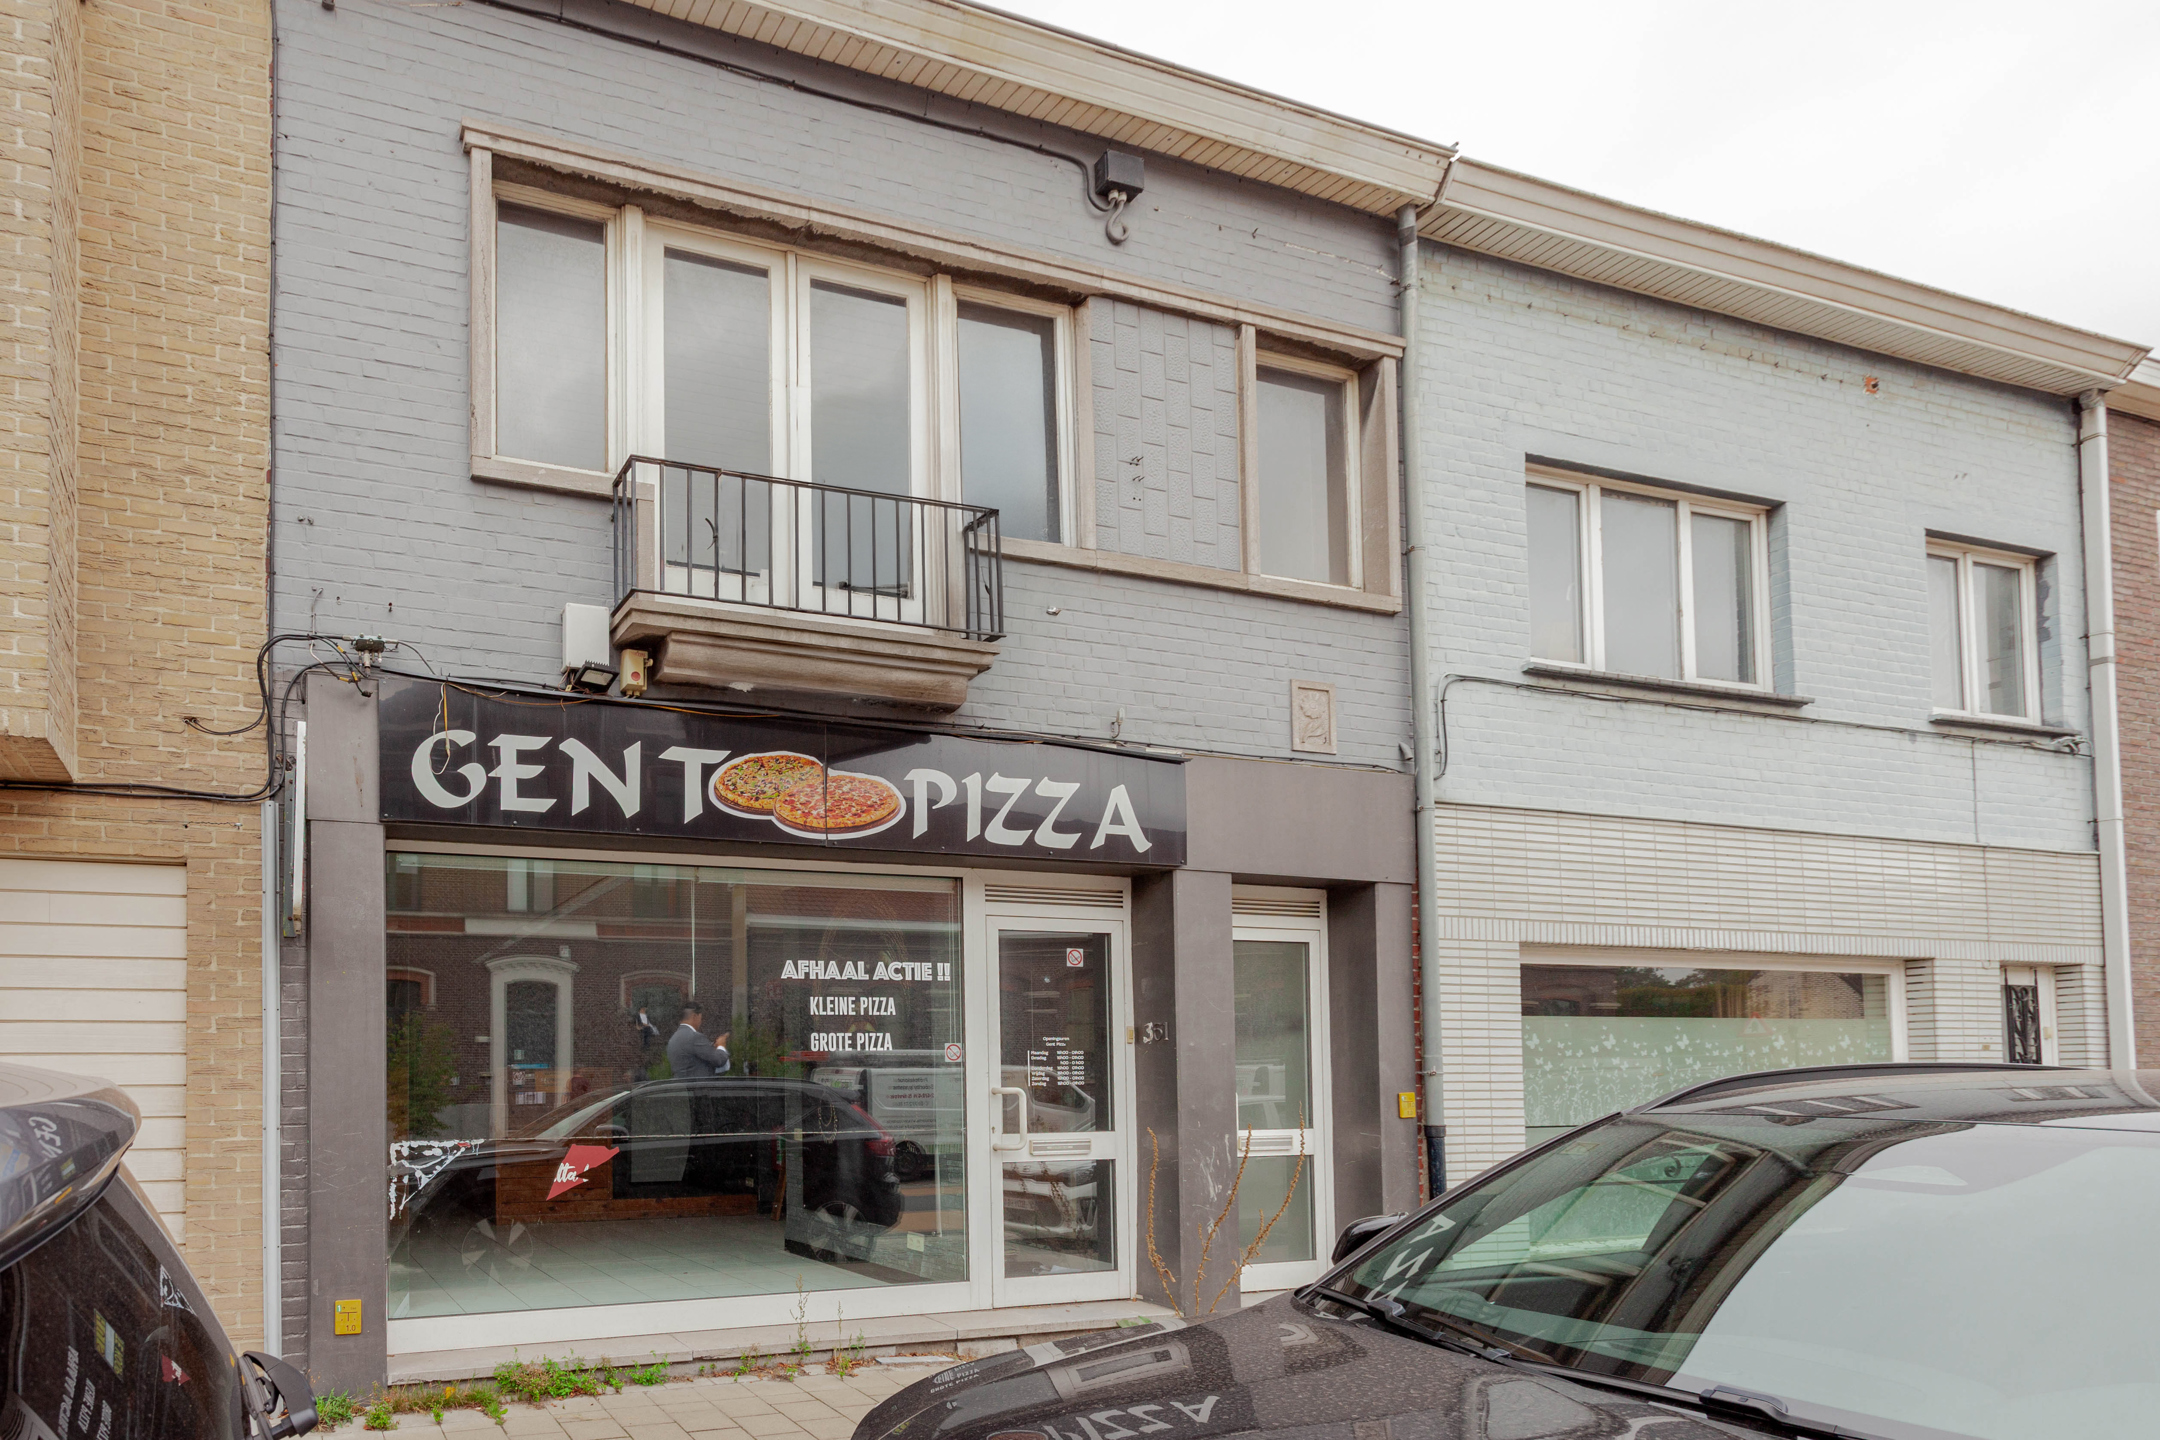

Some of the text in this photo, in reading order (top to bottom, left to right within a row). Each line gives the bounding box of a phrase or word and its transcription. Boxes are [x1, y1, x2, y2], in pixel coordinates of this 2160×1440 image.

[411, 729, 1152, 853] GENT PIZZA
[781, 959, 869, 980] AFHAAL
[873, 961, 933, 981] ACTIE
[810, 996, 896, 1016] KLEINE PIZZA
[811, 1032, 893, 1052] GROTE PIZZA
